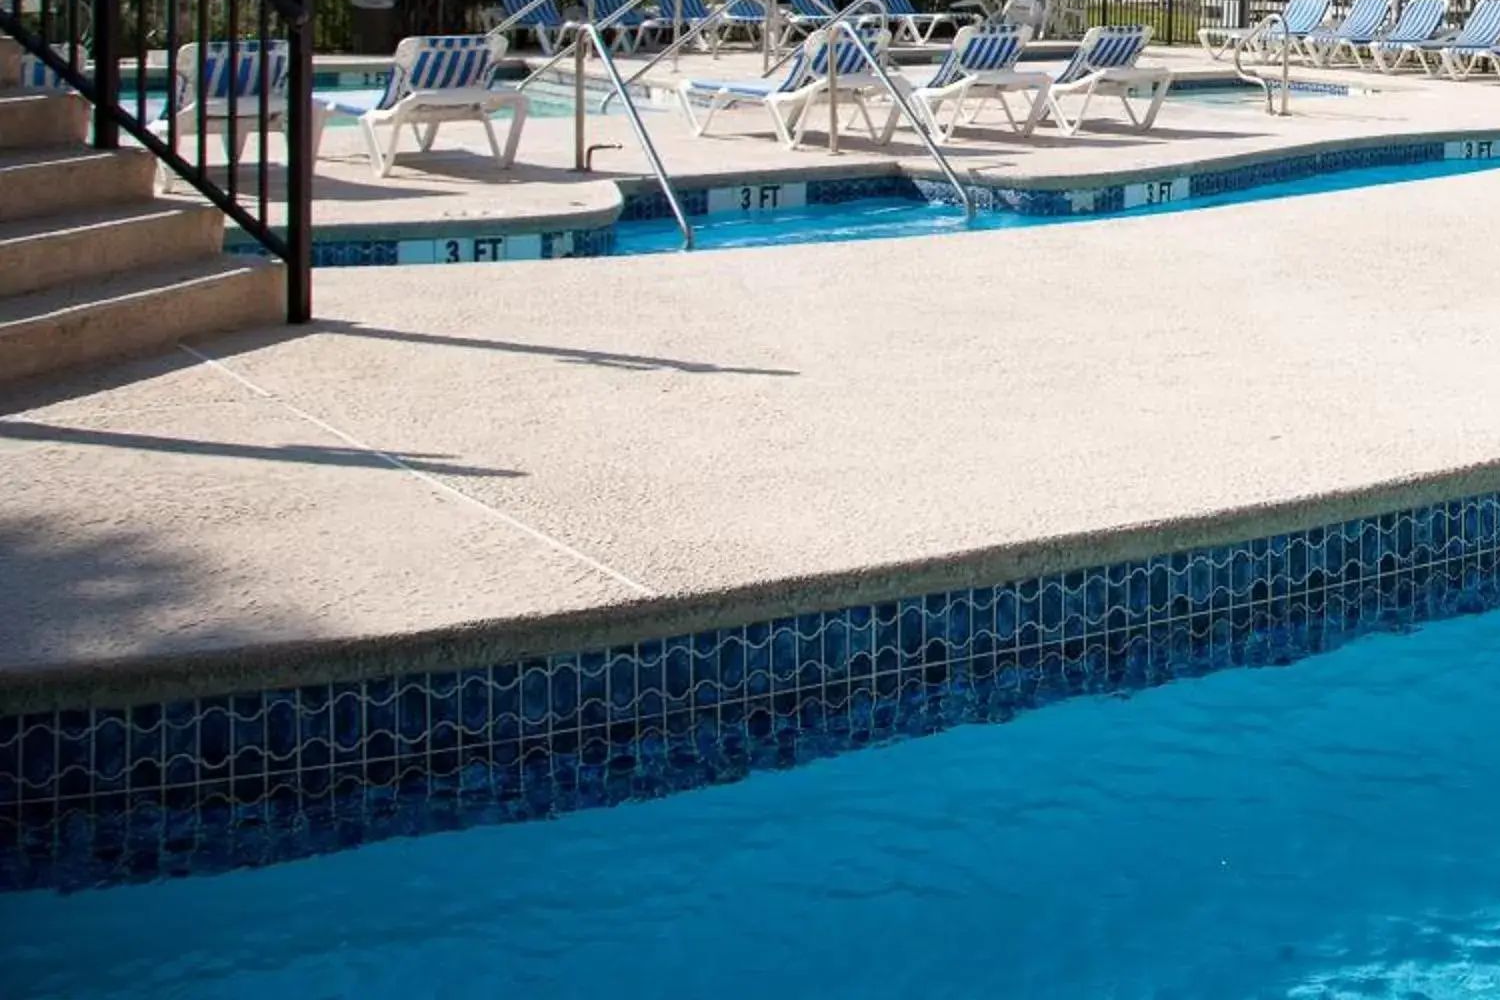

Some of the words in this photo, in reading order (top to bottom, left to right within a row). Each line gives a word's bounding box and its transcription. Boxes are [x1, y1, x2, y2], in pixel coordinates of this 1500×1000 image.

[1465, 142, 1472, 159] 3
[1479, 141, 1492, 159] FT
[741, 187, 751, 210] 3
[760, 185, 780, 208] FT
[1160, 182, 1172, 203] FT
[446, 240, 459, 262] 3
[474, 238, 502, 262] FT
